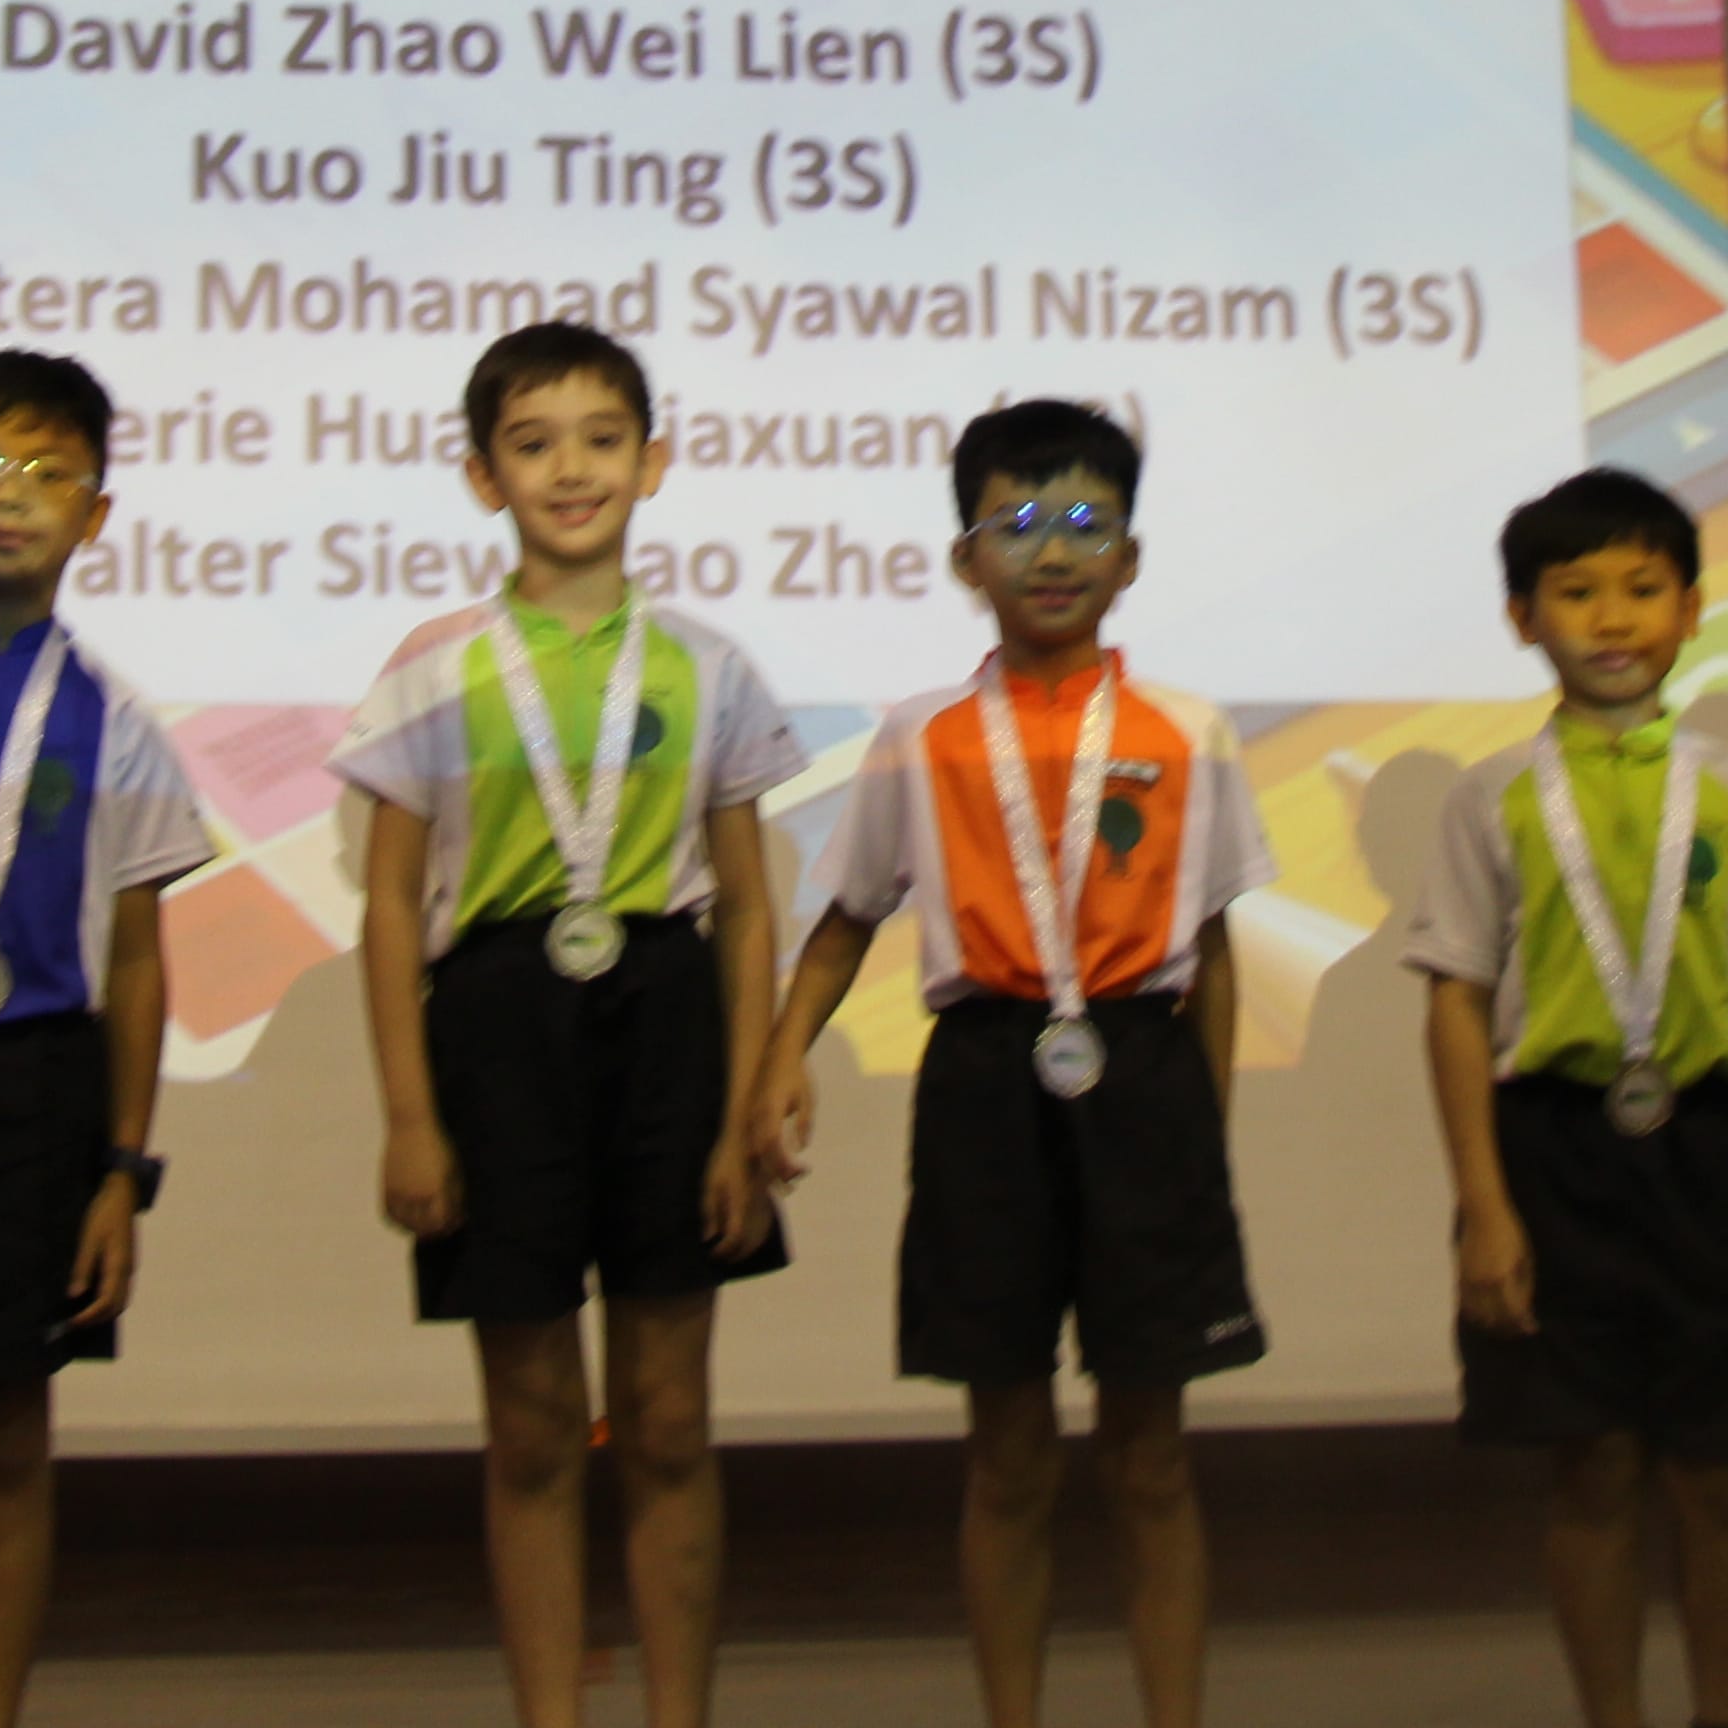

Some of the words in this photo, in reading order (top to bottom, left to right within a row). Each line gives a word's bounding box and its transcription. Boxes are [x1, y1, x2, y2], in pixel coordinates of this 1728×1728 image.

[0, 0, 253, 76] David
[282, 0, 503, 78] Zhao
[530, 7, 704, 82] Wei
[735, 10, 910, 85] Lien
[939, 10, 1103, 104] (3S)
[192, 131, 364, 205] Kuo
[389, 129, 508, 206] Jiu
[536, 132, 726, 228] Ting
[753, 130, 919, 228] (3S)
[200, 258, 657, 336] Mohamad
[689, 263, 999, 358] Syawal
[1030, 266, 1299, 343] Nizam
[1325, 264, 1485, 362] (3S)
[107, 389, 270, 466] erie
[307, 392, 469, 466] Hua
[657, 391, 954, 469] iaxuan
[73, 520, 291, 598] alter
[634, 541, 740, 599] ao
[769, 522, 930, 599] Zhe
